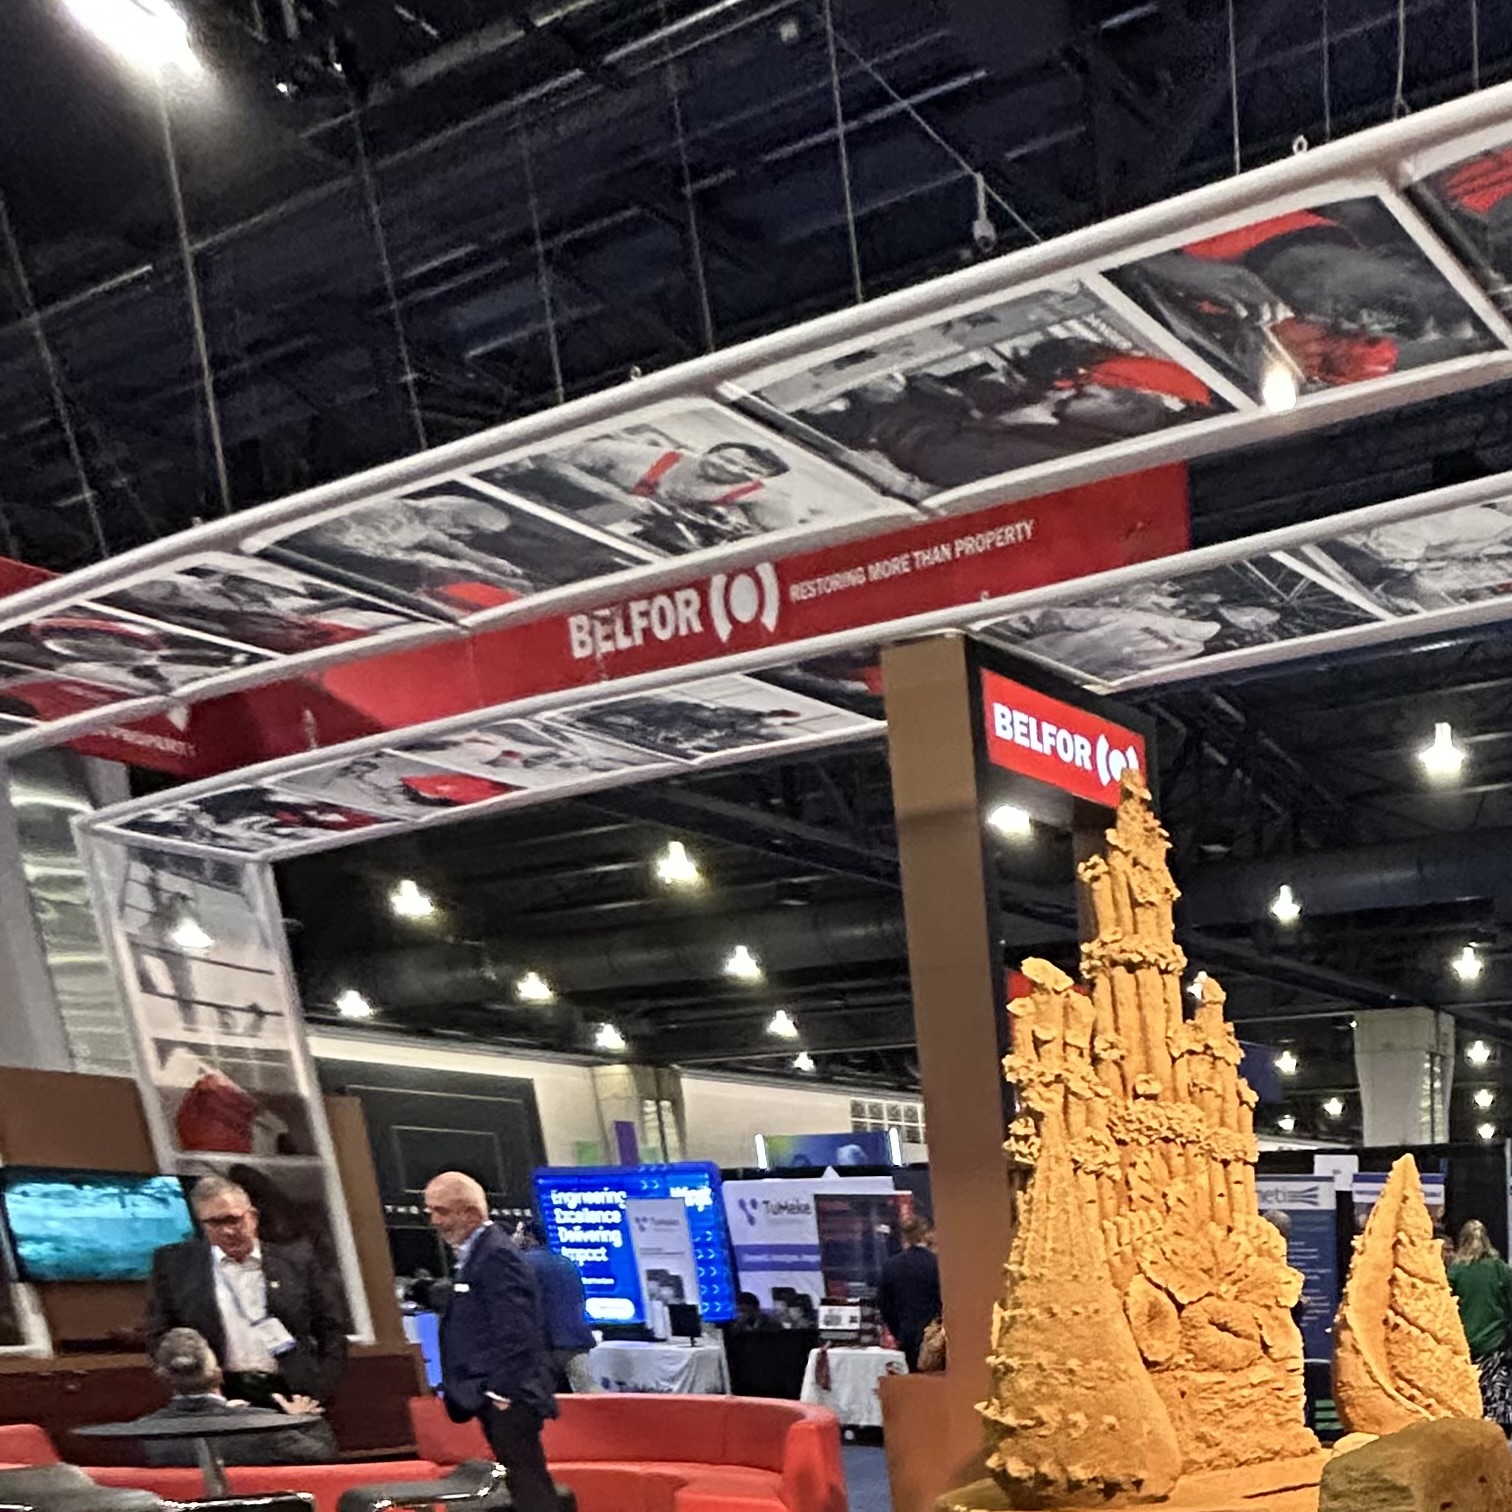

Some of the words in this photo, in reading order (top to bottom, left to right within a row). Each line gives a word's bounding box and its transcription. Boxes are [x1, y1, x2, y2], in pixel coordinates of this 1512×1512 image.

[789, 566, 866, 602] RESTORING
[868, 556, 911, 581] MORE
[913, 543, 951, 569] THAN
[954, 519, 1034, 557] PROPERTY
[569, 588, 703, 659] BELFOR
[993, 702, 1092, 771] BELFOR
